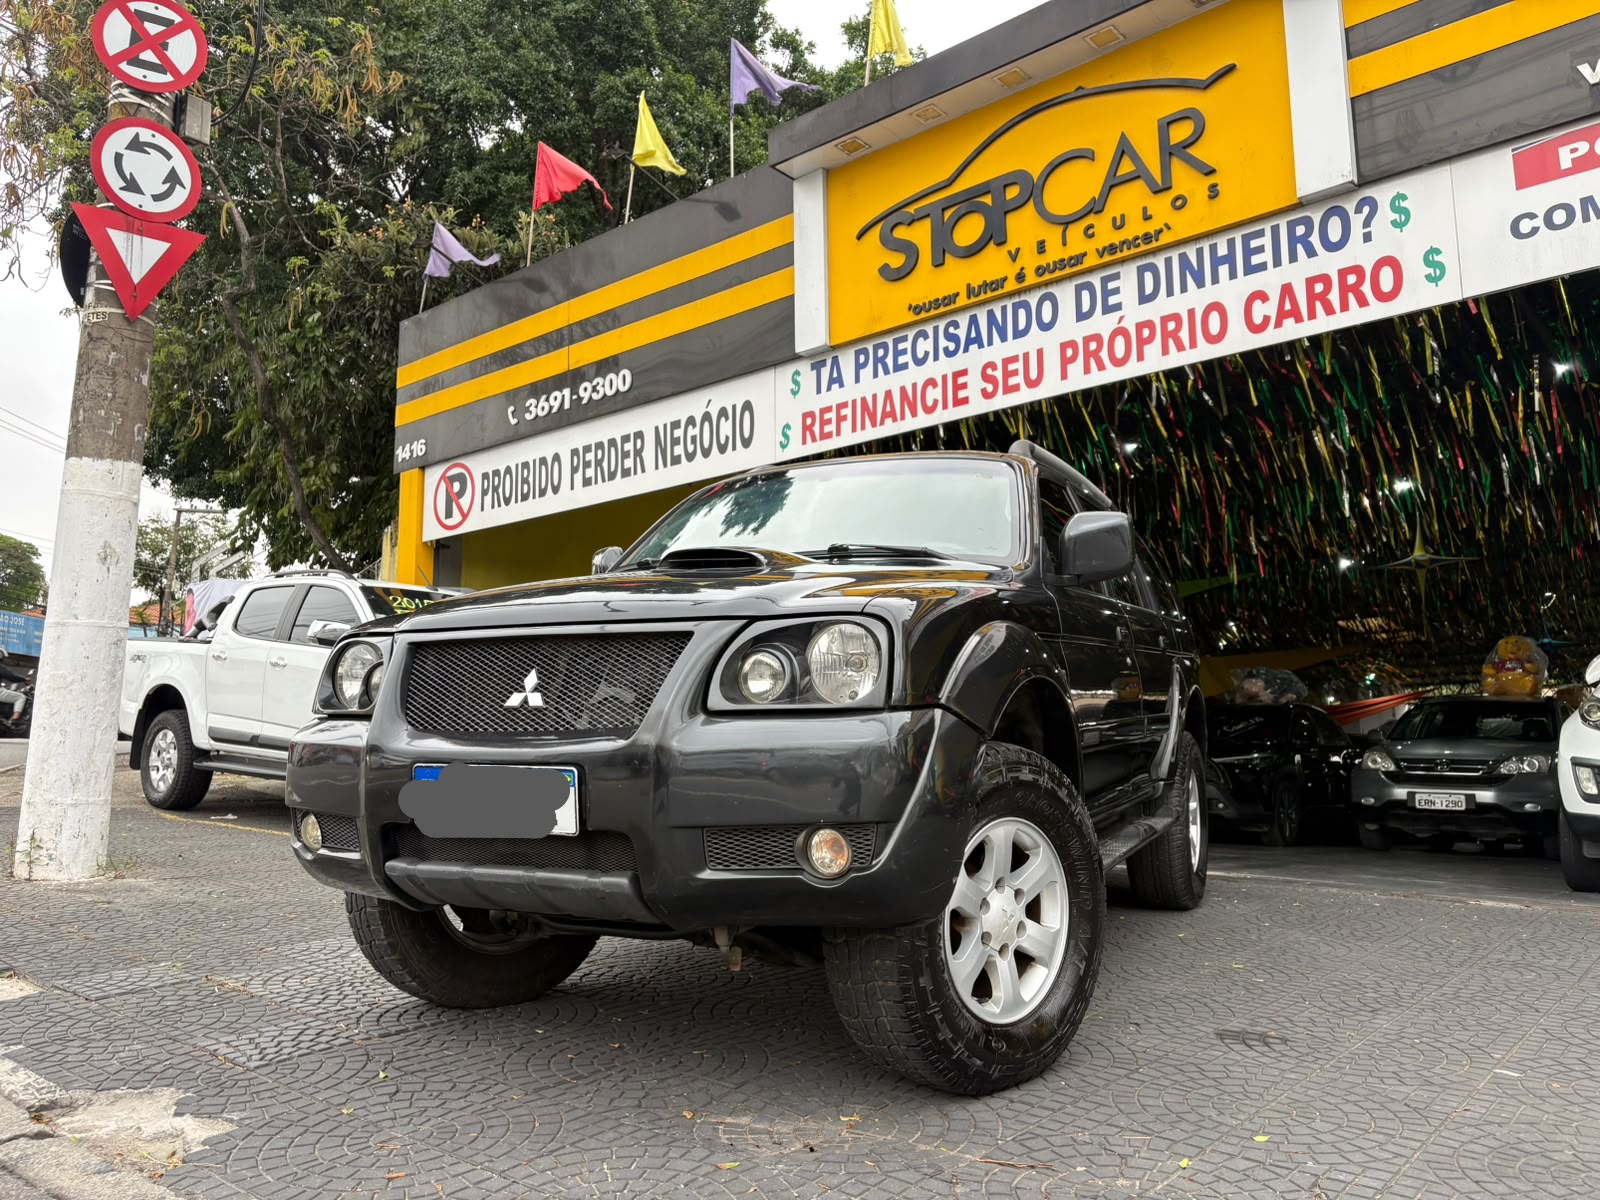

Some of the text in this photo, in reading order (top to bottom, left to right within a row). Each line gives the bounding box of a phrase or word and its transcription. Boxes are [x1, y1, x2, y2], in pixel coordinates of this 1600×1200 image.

[1558, 134, 1600, 171] P
[1007, 182, 1220, 263] VEÍCULOS
[810, 355, 845, 395] TA
[854, 291, 1059, 385] PRECISANDO
[1074, 270, 1124, 323] DE
[1136, 195, 1380, 306] DINHEIRO?
[966, 273, 1008, 298] lutar
[1014, 266, 1026, 284] é
[1034, 250, 1088, 278] ousar
[801, 367, 970, 446] REFINANCIE
[979, 347, 1045, 401] SEU
[1059, 301, 1229, 382] PRÓPRIO
[1243, 255, 1404, 335] CARRO
[524, 368, 633, 421] 3691-9300
[395, 438, 427, 463] 1416
[480, 398, 755, 512] PROIBIDO PERDER NEGÓCIO
